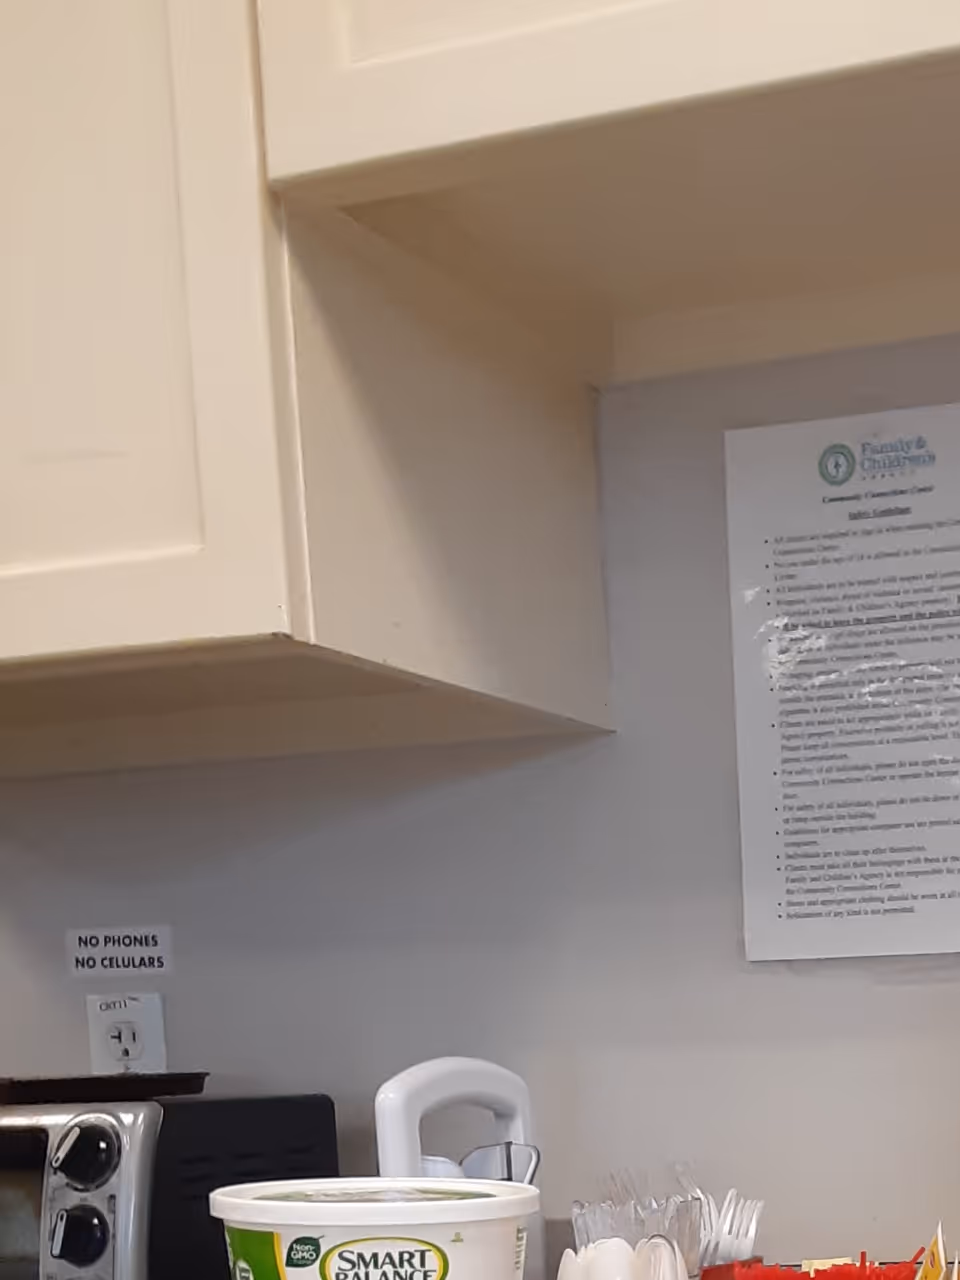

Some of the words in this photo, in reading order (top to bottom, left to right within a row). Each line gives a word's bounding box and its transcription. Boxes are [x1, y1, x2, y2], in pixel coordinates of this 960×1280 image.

[78, 935, 100, 948] NO
[103, 934, 159, 948] PHONES
[75, 956, 97, 969] NO
[101, 955, 165, 969] CELULARS
[290, 1250, 317, 1261] GMO
[337, 1249, 433, 1272] SMART
